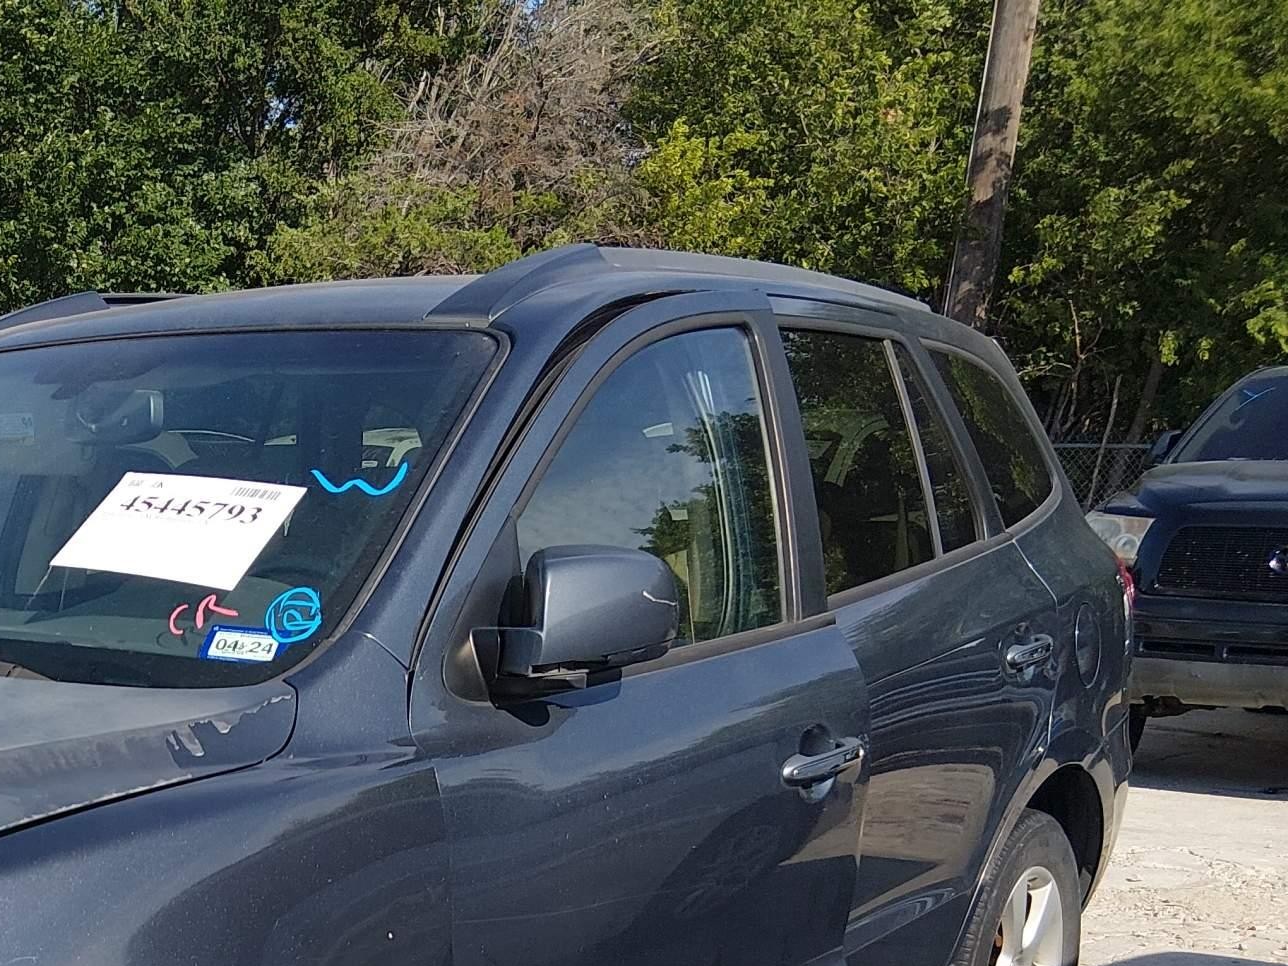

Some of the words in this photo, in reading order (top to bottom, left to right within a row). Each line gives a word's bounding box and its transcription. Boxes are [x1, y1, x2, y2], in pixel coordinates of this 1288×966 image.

[120, 495, 263, 524] 45445793
[215, 638, 239, 652] 04
[248, 641, 274, 655] 24
